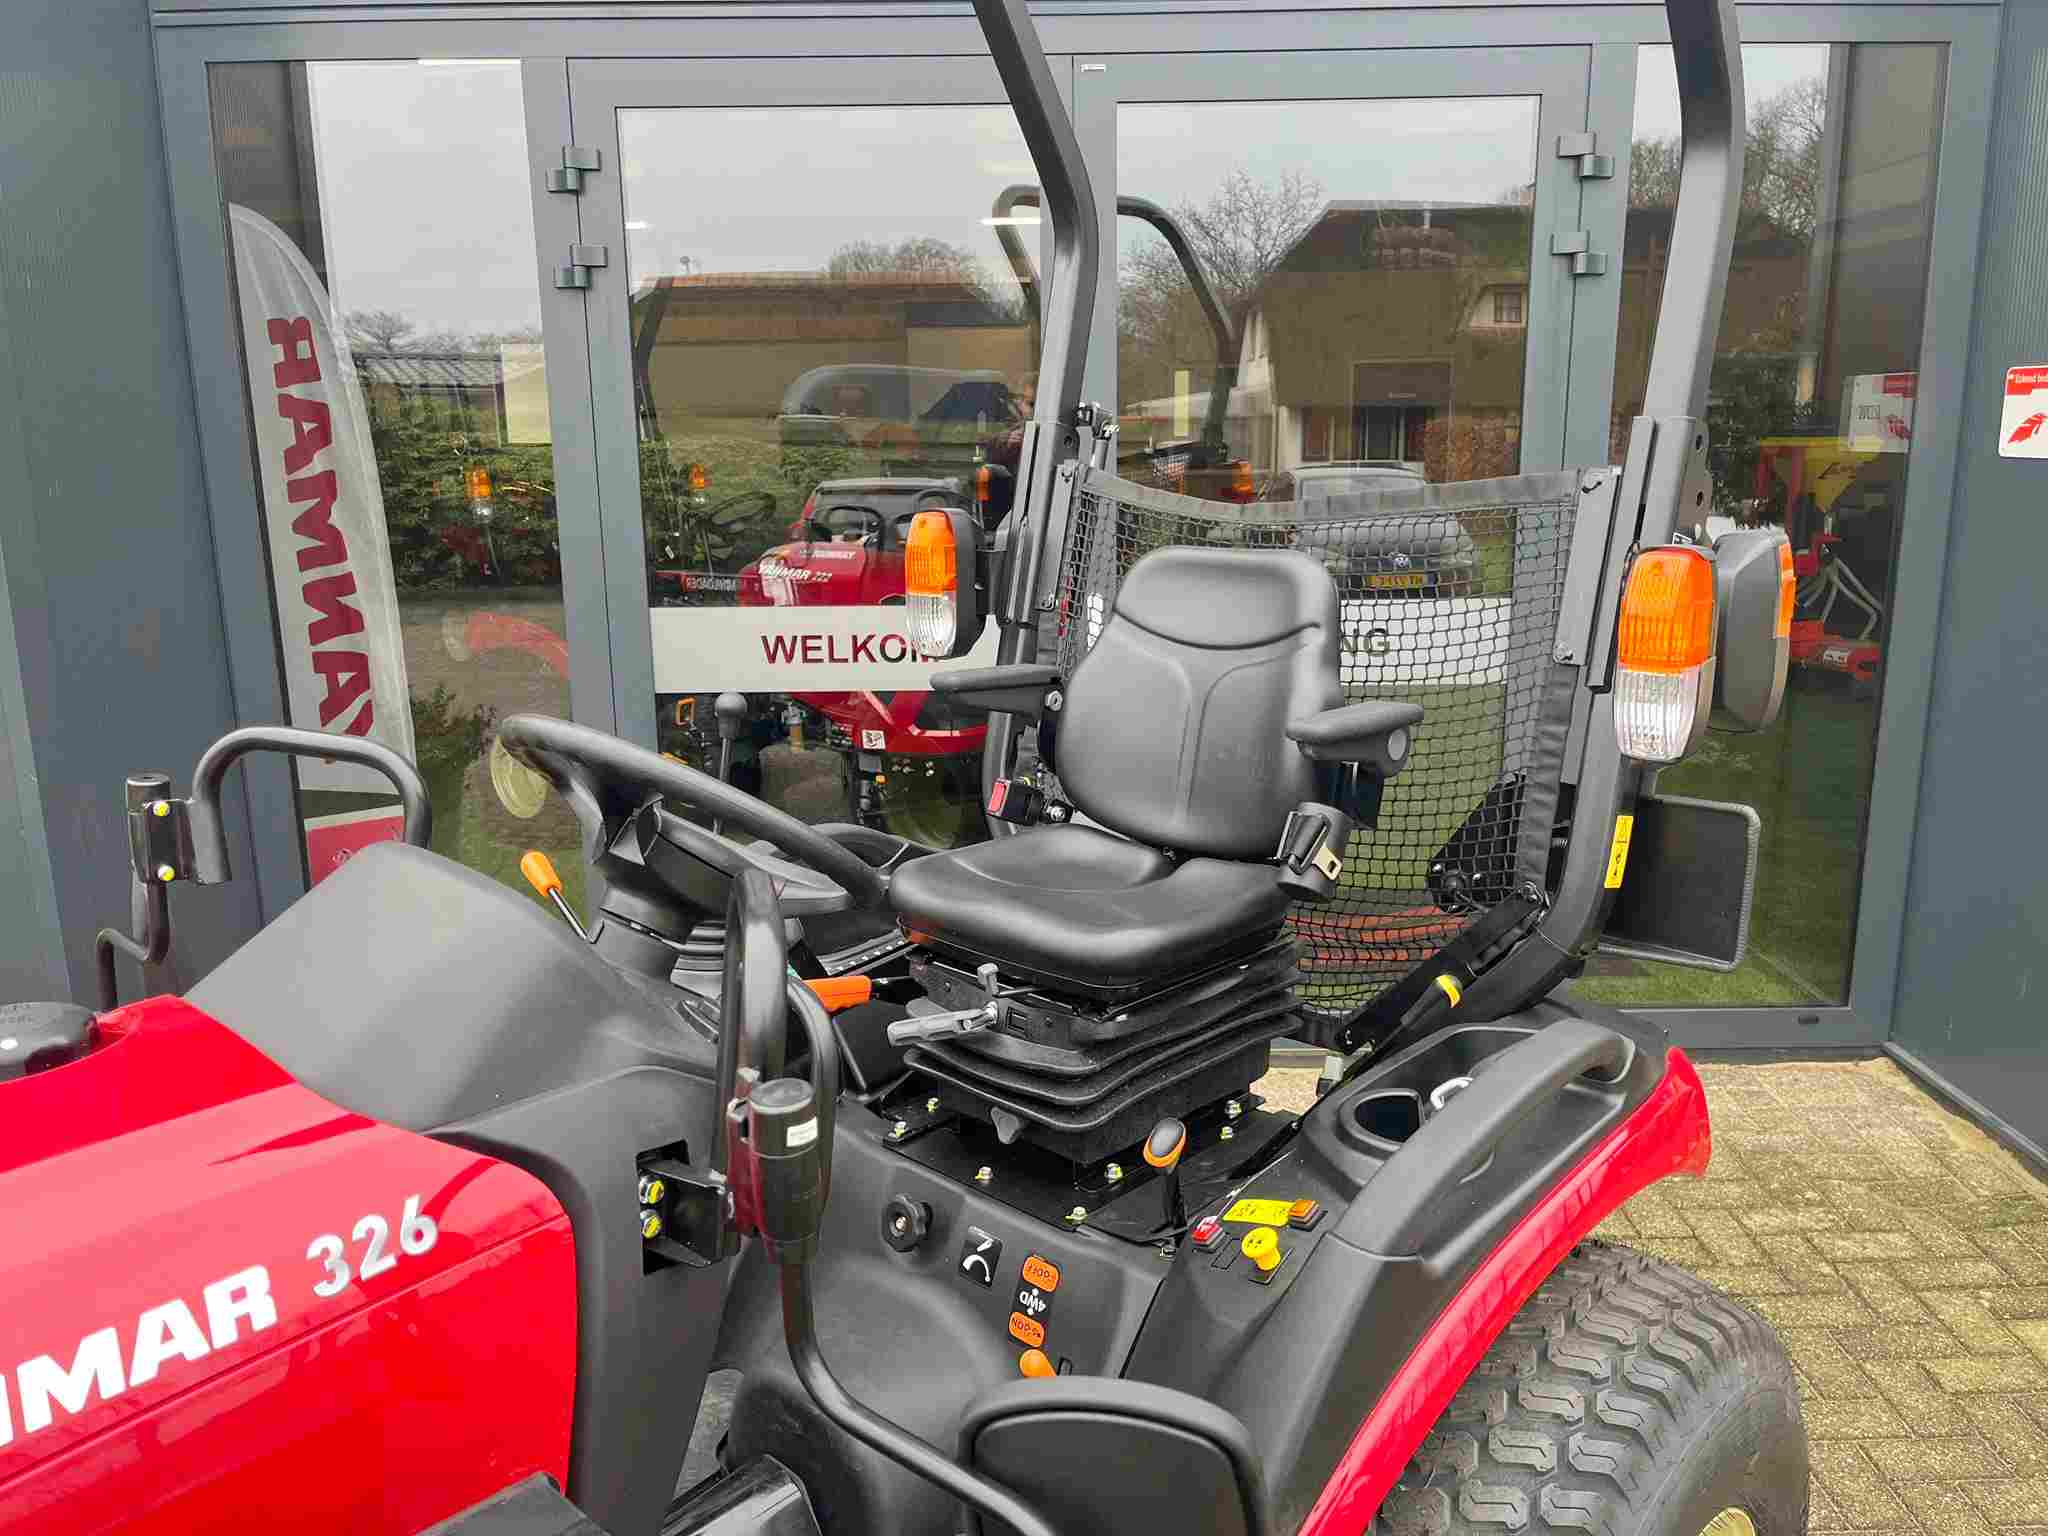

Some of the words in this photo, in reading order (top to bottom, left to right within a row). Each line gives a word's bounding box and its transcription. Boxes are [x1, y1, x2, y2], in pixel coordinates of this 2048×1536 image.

[0, 1264, 279, 1449] MAR
[305, 1194, 439, 1298] 326
[1018, 1290, 1047, 1313] 4WD
